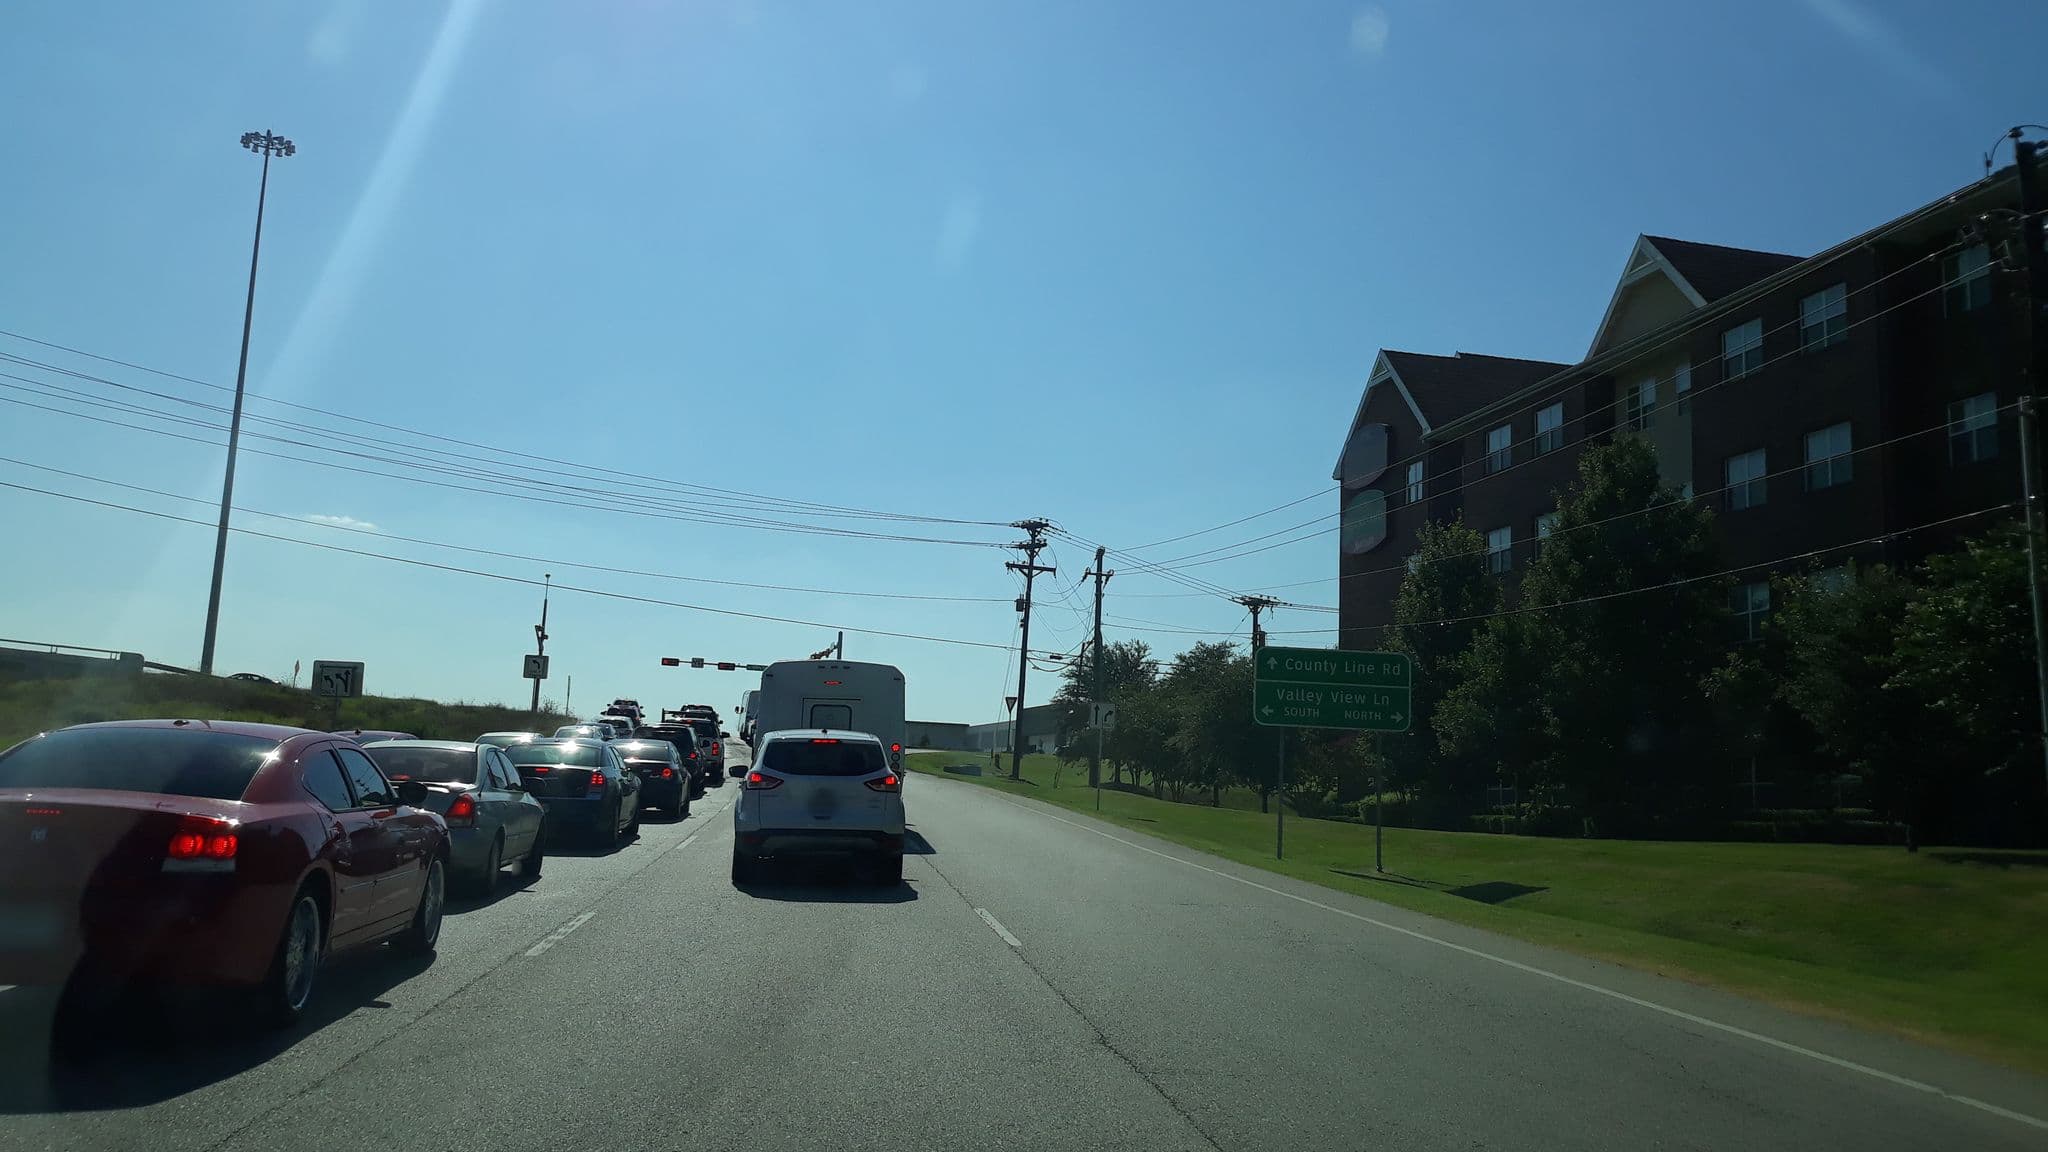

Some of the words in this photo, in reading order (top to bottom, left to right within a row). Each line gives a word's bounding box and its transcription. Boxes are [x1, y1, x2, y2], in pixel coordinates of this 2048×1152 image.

[1285, 657, 1337, 676] County
[1345, 661, 1375, 674] Line
[1383, 663, 1401, 676] Rd
[1276, 688, 1323, 705] Valley
[1330, 690, 1366, 704] View
[1374, 693, 1390, 705] Ln
[1284, 707, 1320, 716] SOUTH
[1345, 710, 1382, 721] NORTH
